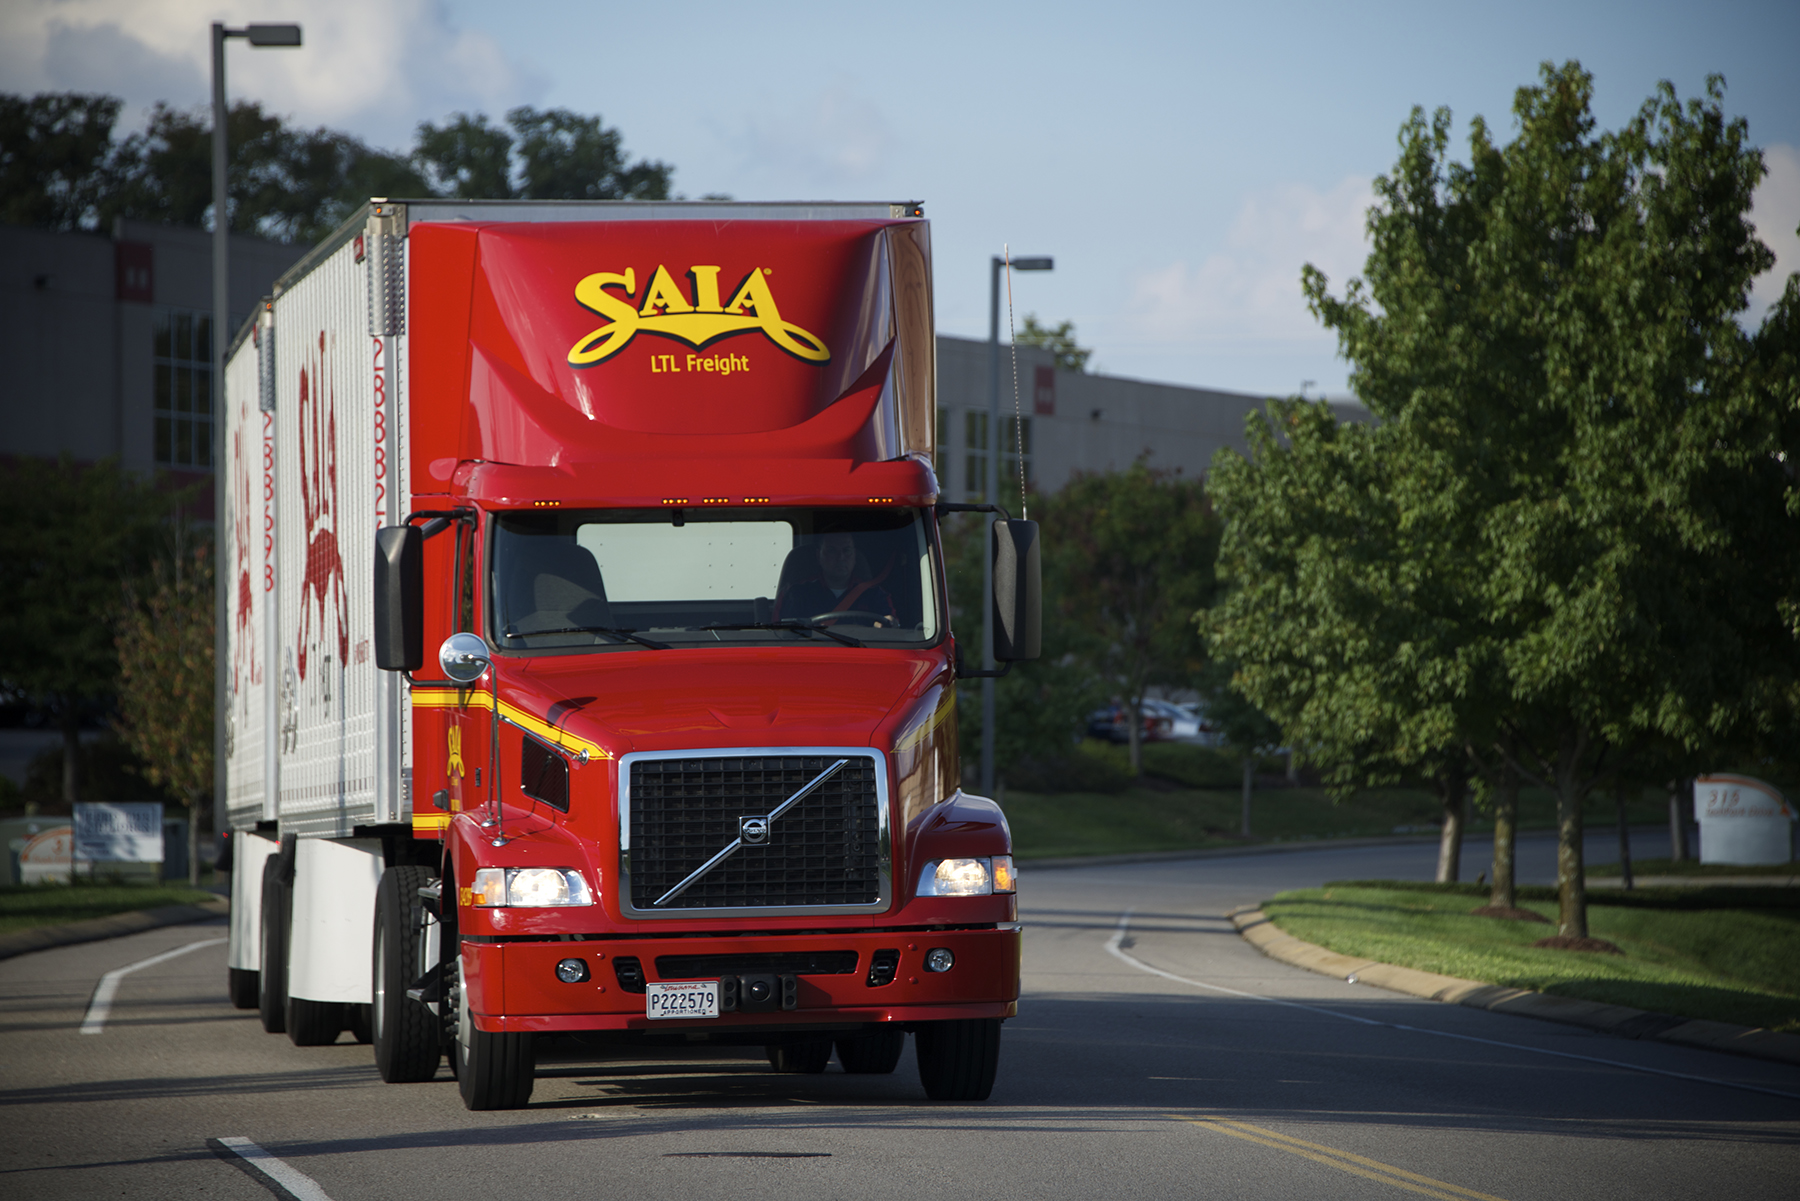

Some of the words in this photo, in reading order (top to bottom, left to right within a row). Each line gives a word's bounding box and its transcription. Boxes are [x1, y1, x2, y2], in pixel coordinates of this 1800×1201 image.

[567, 264, 831, 368] SAIA
[651, 355, 681, 373] LTL
[686, 353, 750, 375] Freight
[373, 338, 386, 530] 28882
[263, 412, 275, 592] 288698
[651, 992, 714, 1010] P222579
